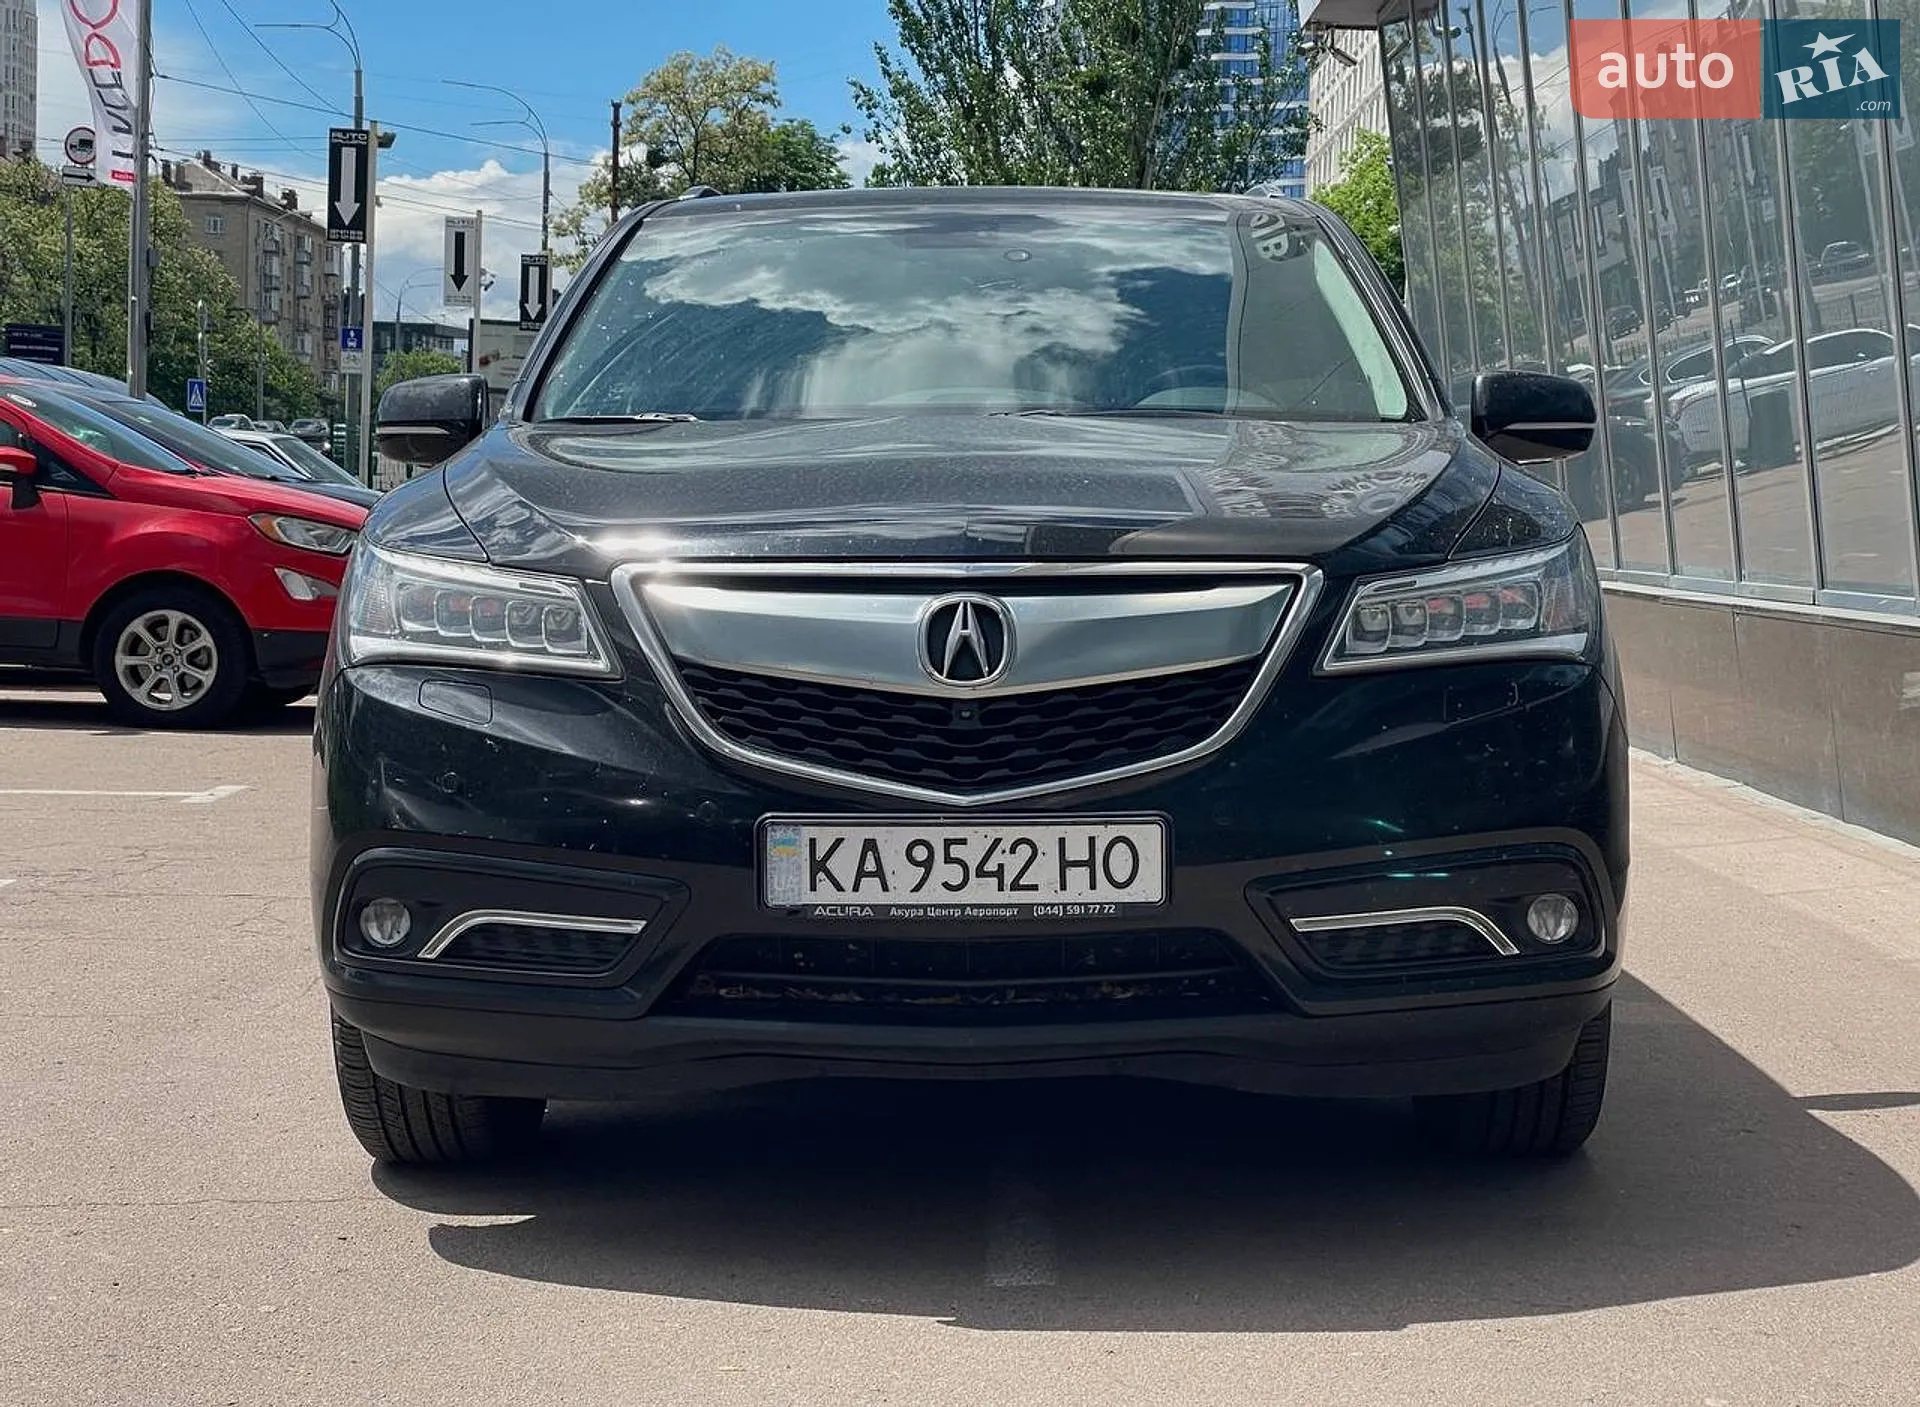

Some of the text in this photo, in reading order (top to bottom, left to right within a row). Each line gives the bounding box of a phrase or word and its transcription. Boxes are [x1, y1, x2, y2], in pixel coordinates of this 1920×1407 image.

[808, 836, 1140, 893] KA 9542 HO
[814, 905, 874, 916] ACURA
[889, 906, 924, 918] Акура
[927, 906, 961, 918] Центр
[1033, 904, 1116, 917] (044) 591 77 72
